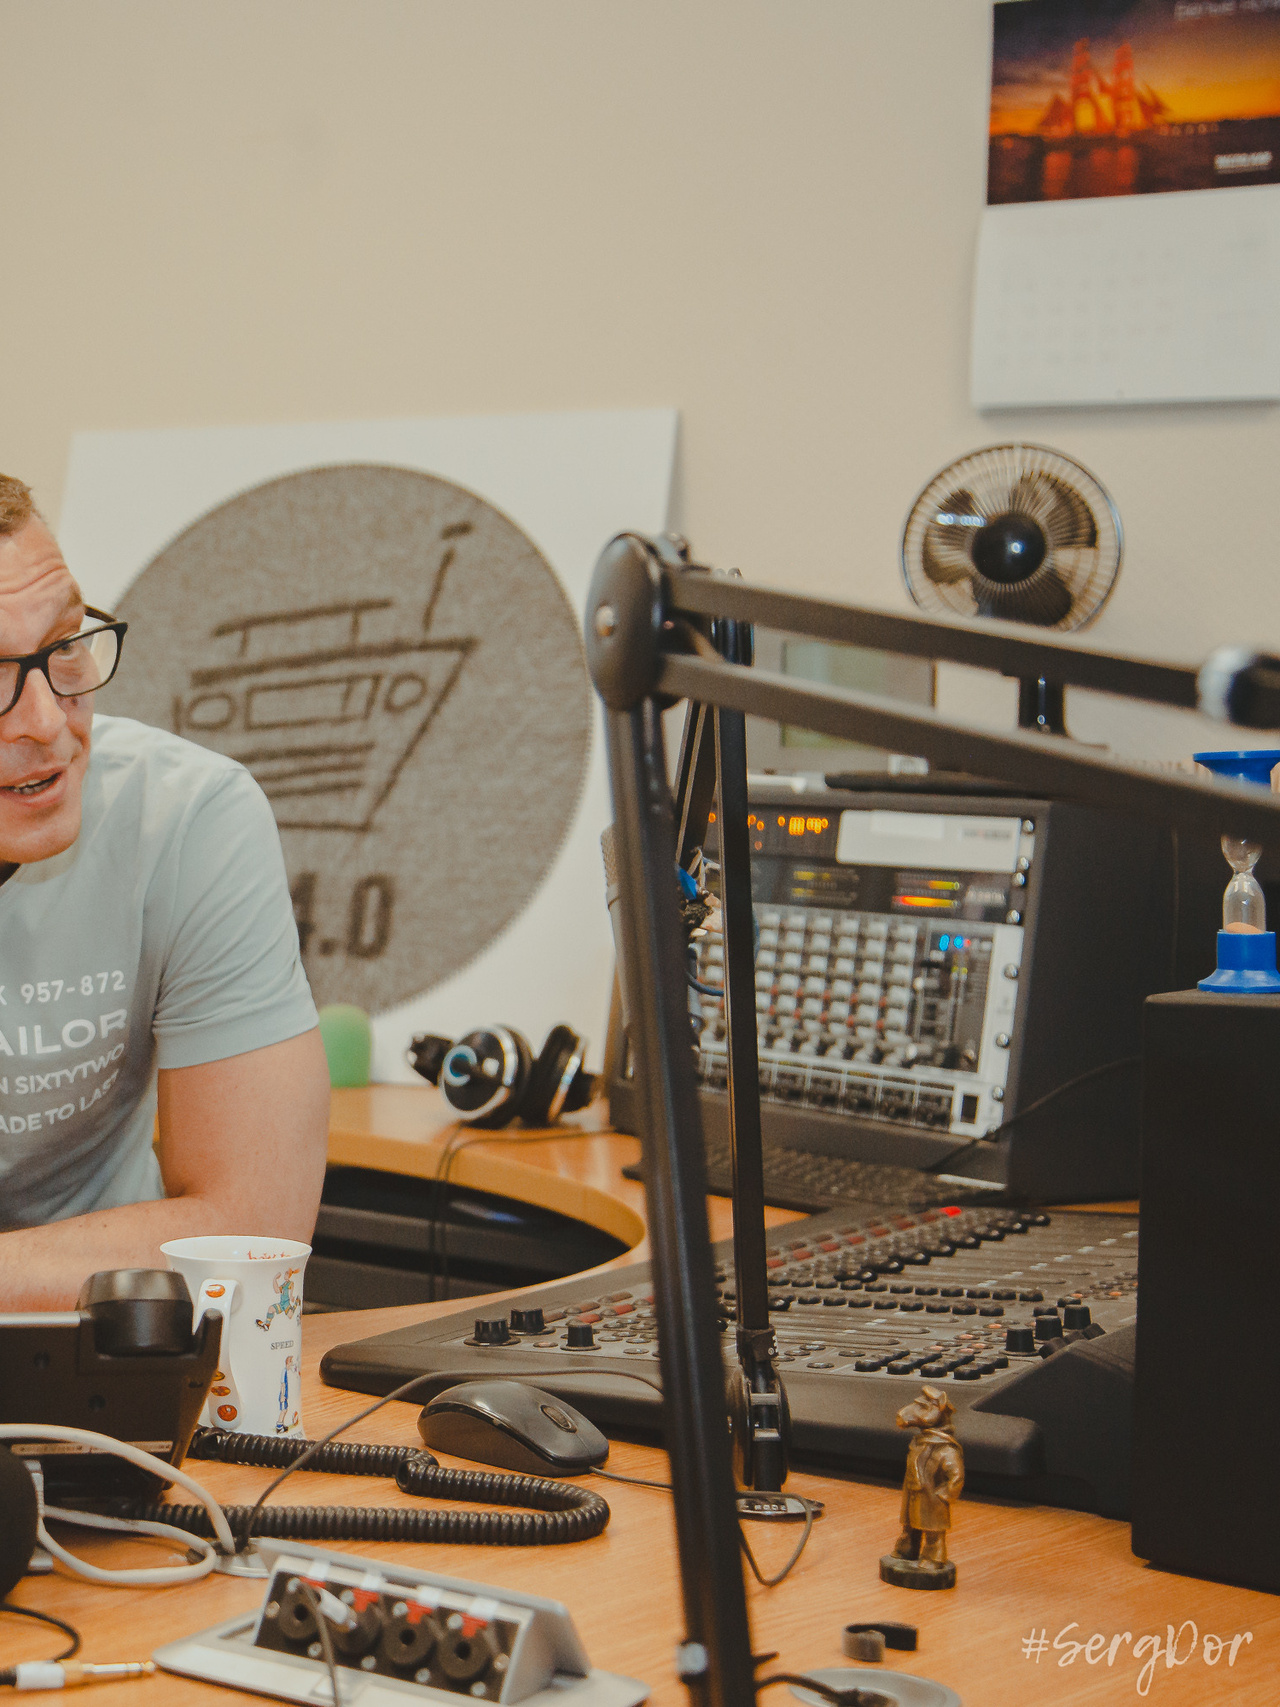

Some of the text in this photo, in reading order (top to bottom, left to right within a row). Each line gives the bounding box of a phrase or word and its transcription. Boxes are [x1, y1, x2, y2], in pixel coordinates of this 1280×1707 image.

[21, 971, 126, 1004] 957-872
[15, 1042, 125, 1095] SIXTYTWO
[45, 1102, 75, 1124] TO
